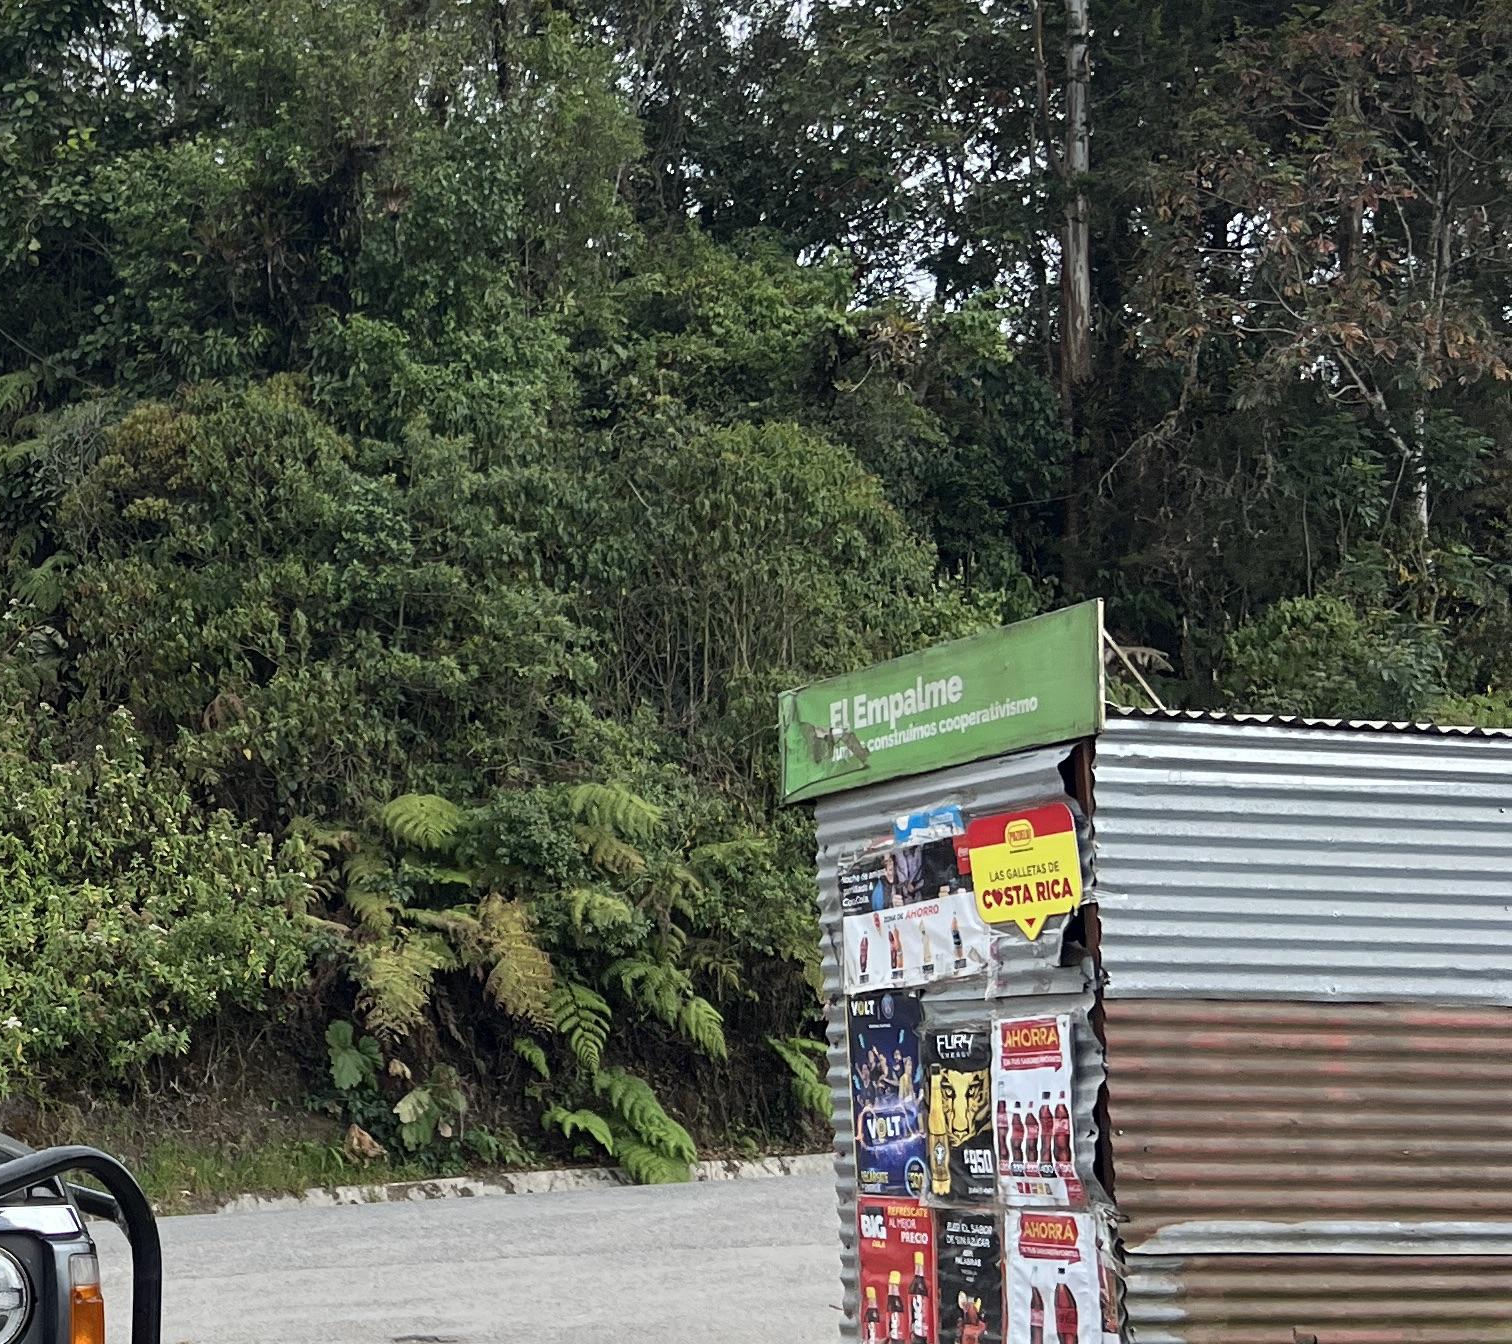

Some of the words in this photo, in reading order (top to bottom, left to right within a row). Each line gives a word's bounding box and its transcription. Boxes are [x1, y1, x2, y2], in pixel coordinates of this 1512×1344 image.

[829, 698, 851, 733] El
[854, 675, 963, 729] Empalme
[939, 696, 1038, 734] cooperativismo
[989, 869, 1005, 883] LAS
[1006, 862, 1047, 880] GALLETAS
[1048, 861, 1060, 873] DE
[1036, 877, 1074, 902] RICA
[905, 904, 939, 920] AHORRO
[850, 999, 875, 1017] VOLT
[936, 1034, 974, 1058] FURY
[866, 1115, 901, 1140] VOLT
[860, 1214, 887, 1240] BIG
[900, 1230, 929, 1245] PRECIO
[1022, 1219, 1075, 1241] AHORRÁ
